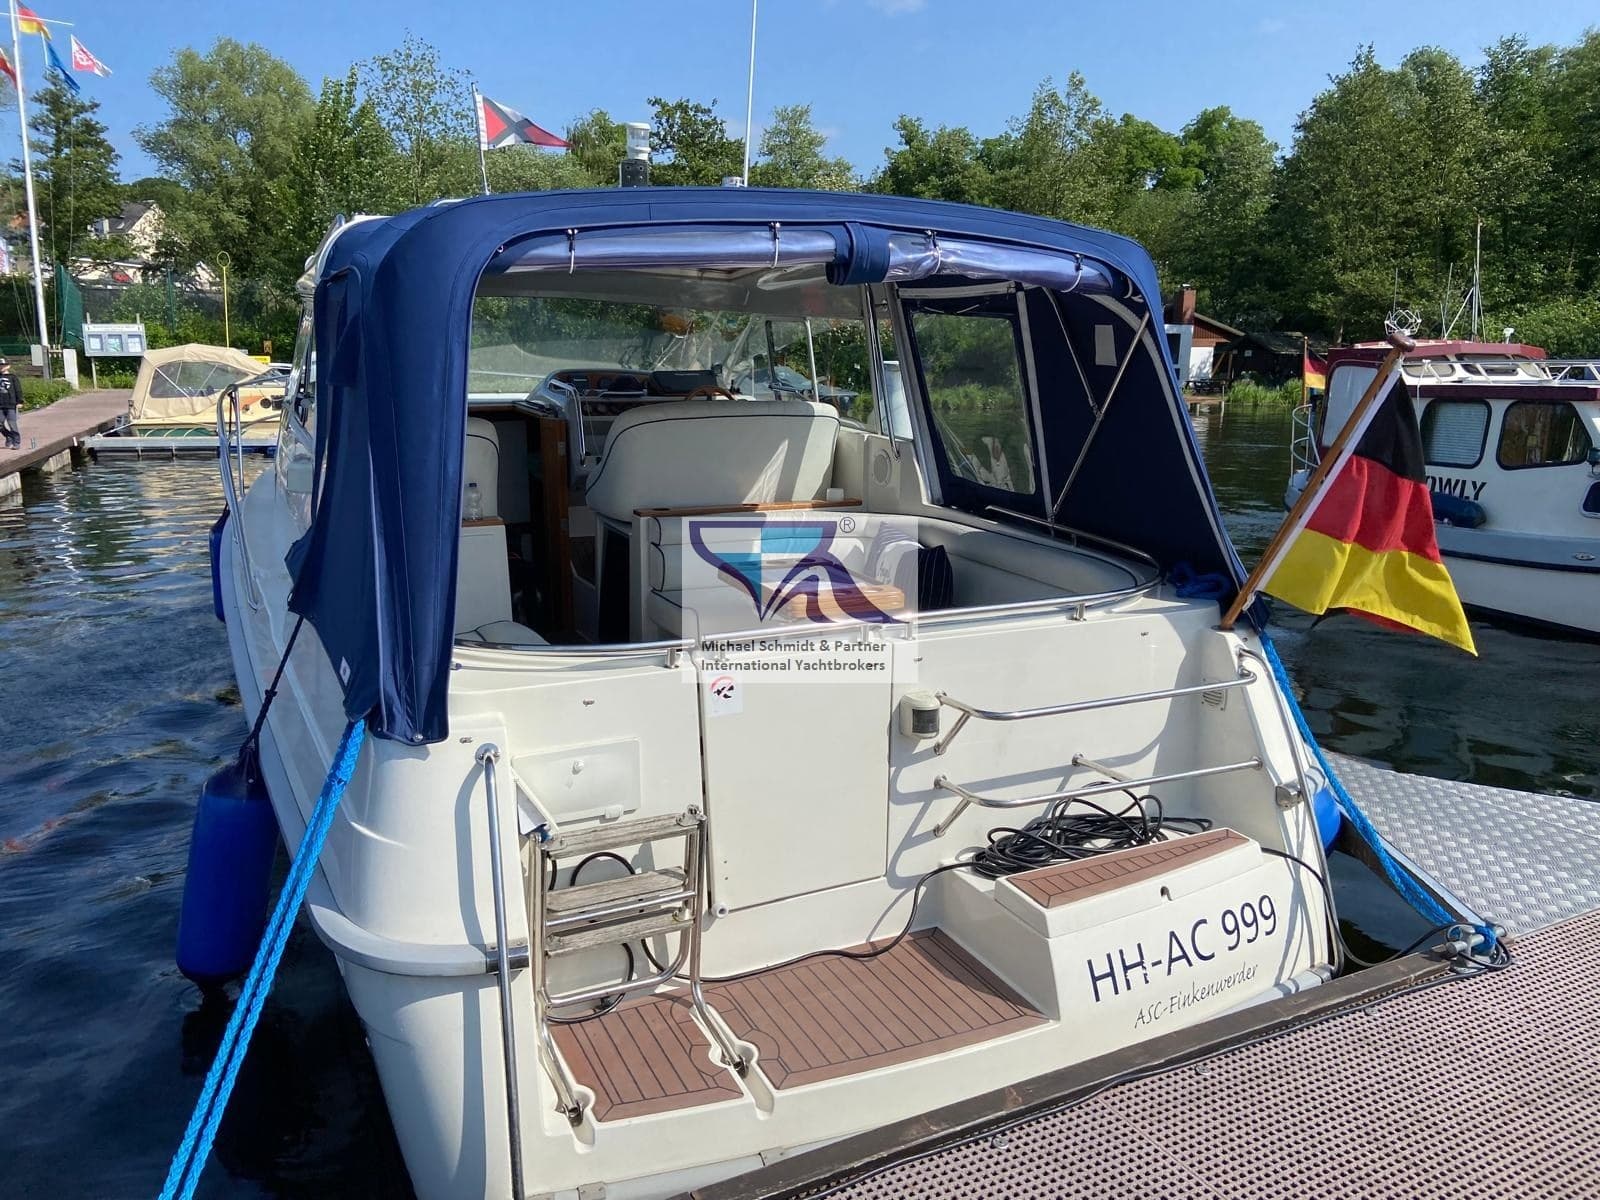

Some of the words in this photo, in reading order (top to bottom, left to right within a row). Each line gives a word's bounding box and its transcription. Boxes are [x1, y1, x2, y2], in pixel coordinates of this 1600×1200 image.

[1086, 918, 1216, 1002] HH-AC
[1221, 894, 1277, 951] 999
[1134, 960, 1259, 1029] ASC-Finkenwerder
